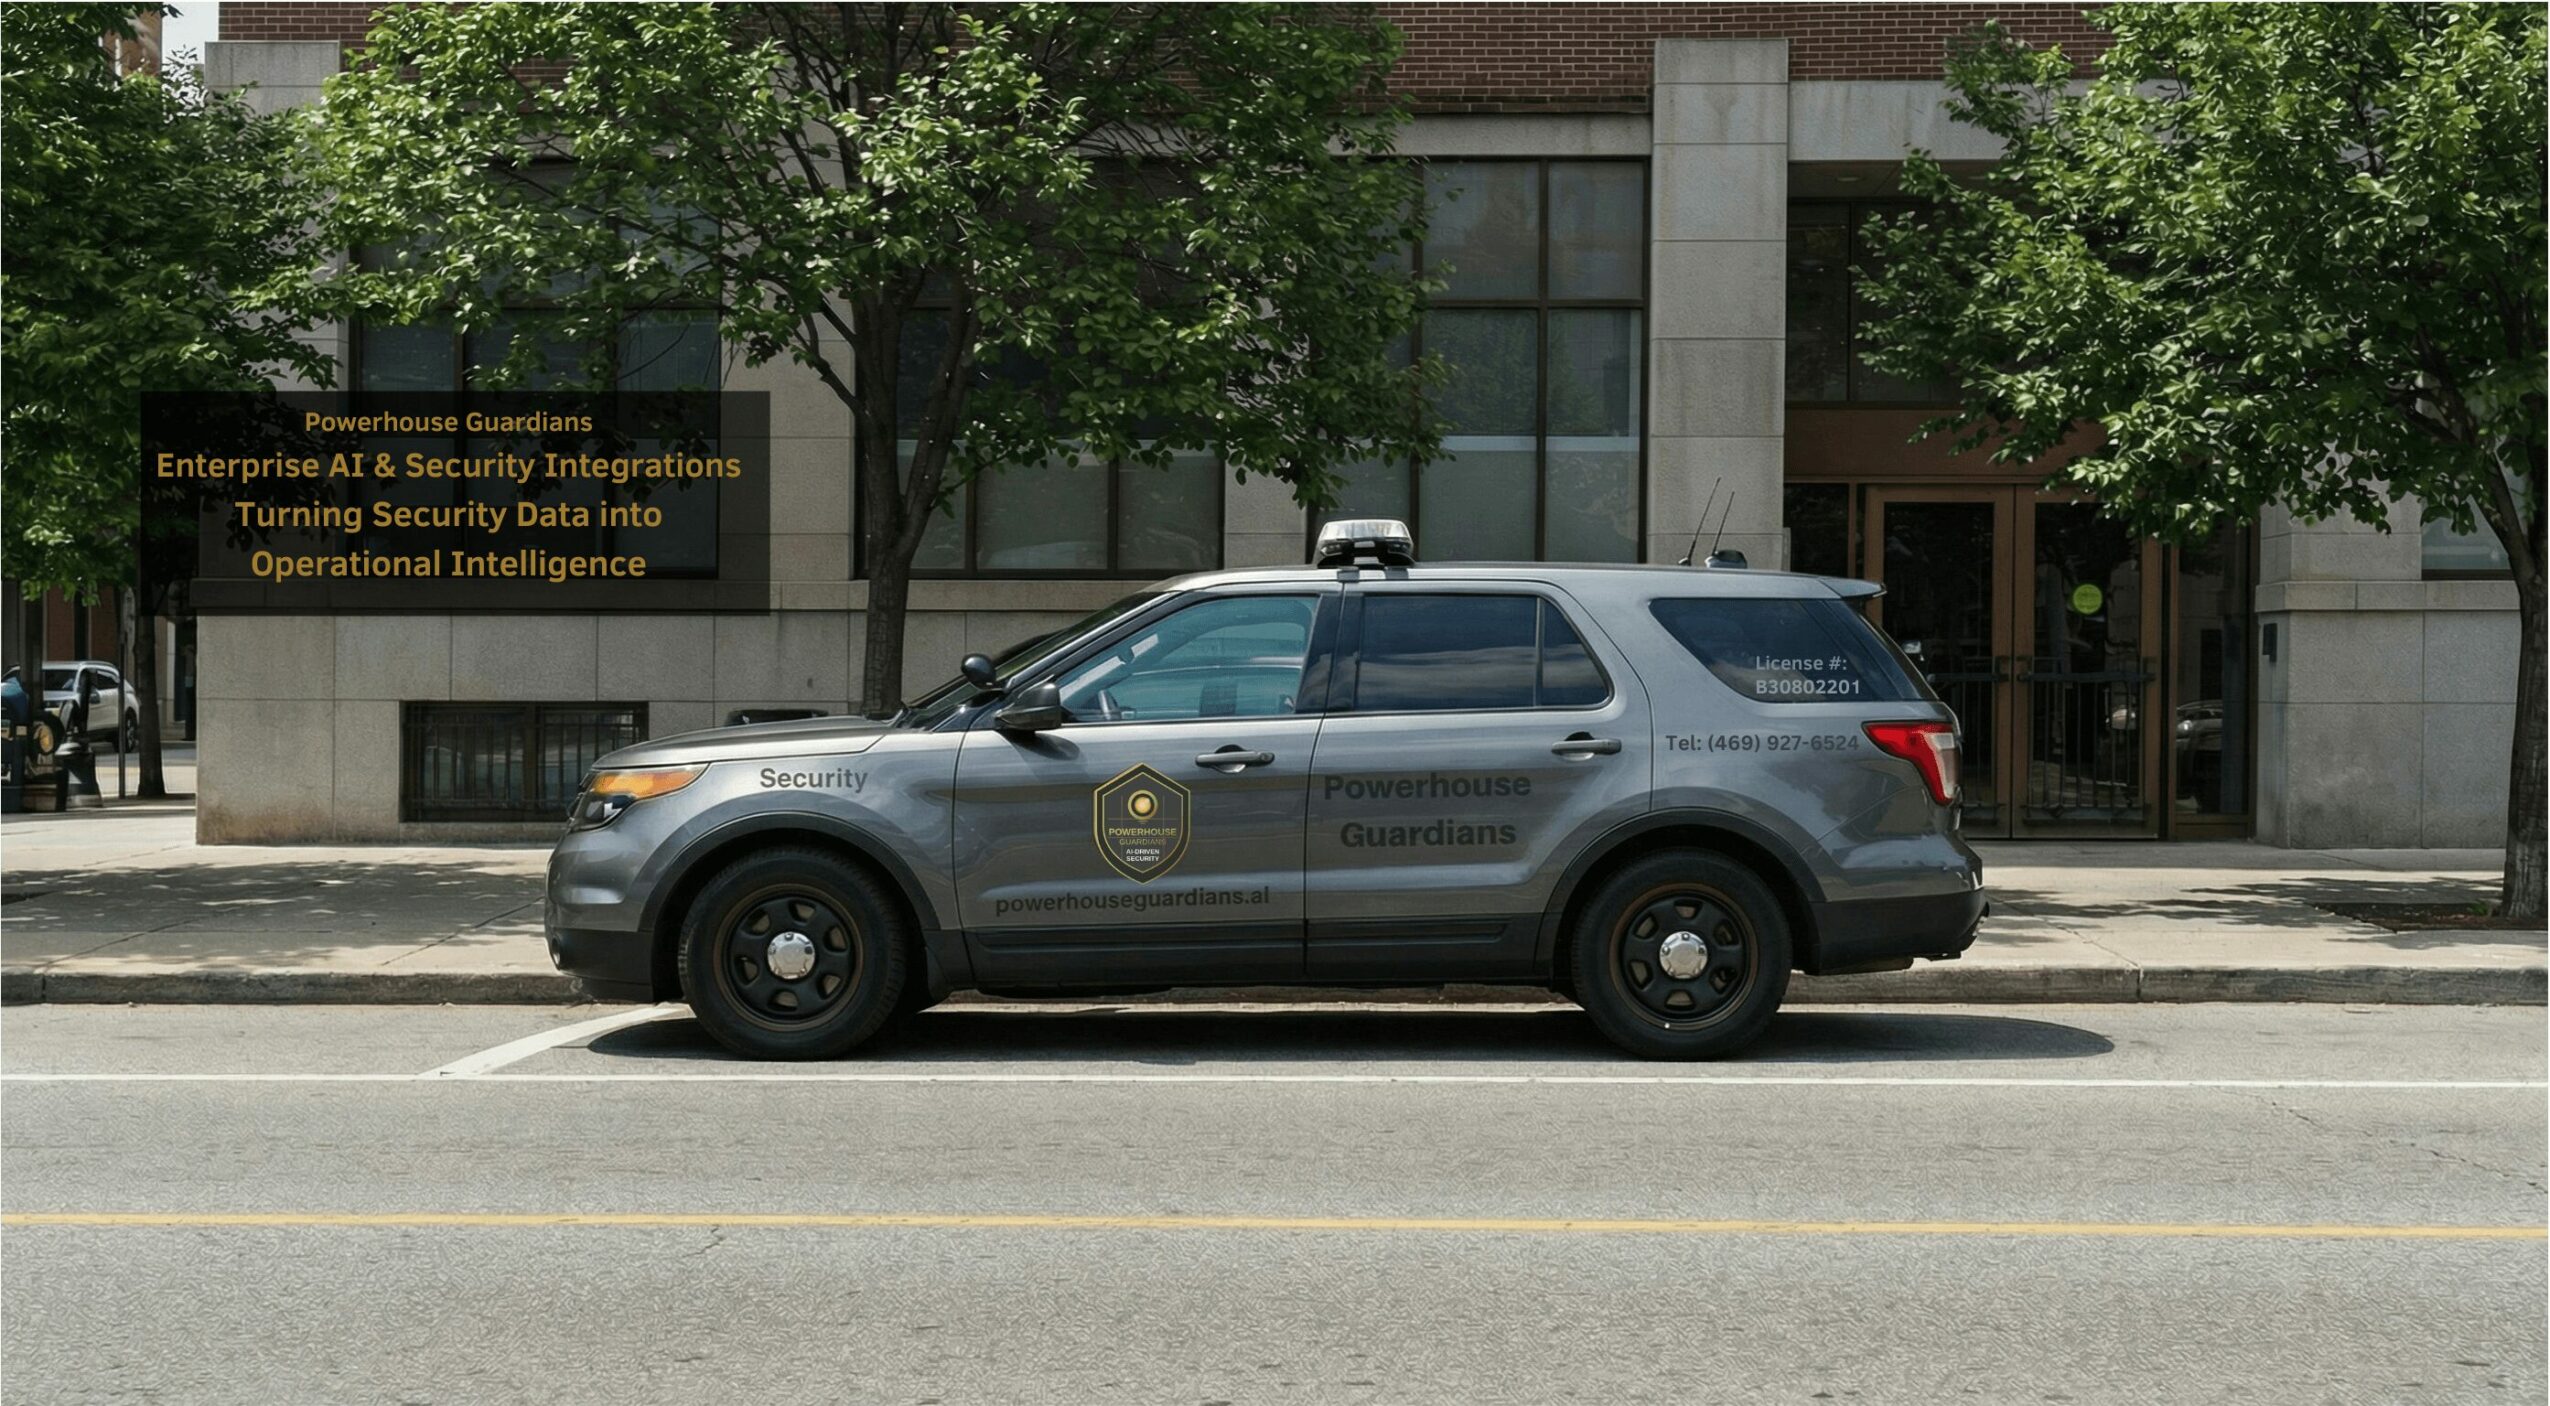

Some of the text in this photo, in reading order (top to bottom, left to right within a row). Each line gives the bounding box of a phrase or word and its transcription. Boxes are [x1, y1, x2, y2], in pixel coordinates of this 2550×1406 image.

[1755, 655, 1848, 672] License #:
[1755, 679, 1861, 695] B30802201
[1665, 734, 1860, 754] Tel: (469) 927-6524
[759, 767, 869, 793] Security
[1323, 772, 1532, 801] Powerhouse
[1108, 828, 1177, 836] POWERHOUSE
[1340, 818, 1517, 848] Guardians
[1119, 838, 1167, 846] GUARDIANS
